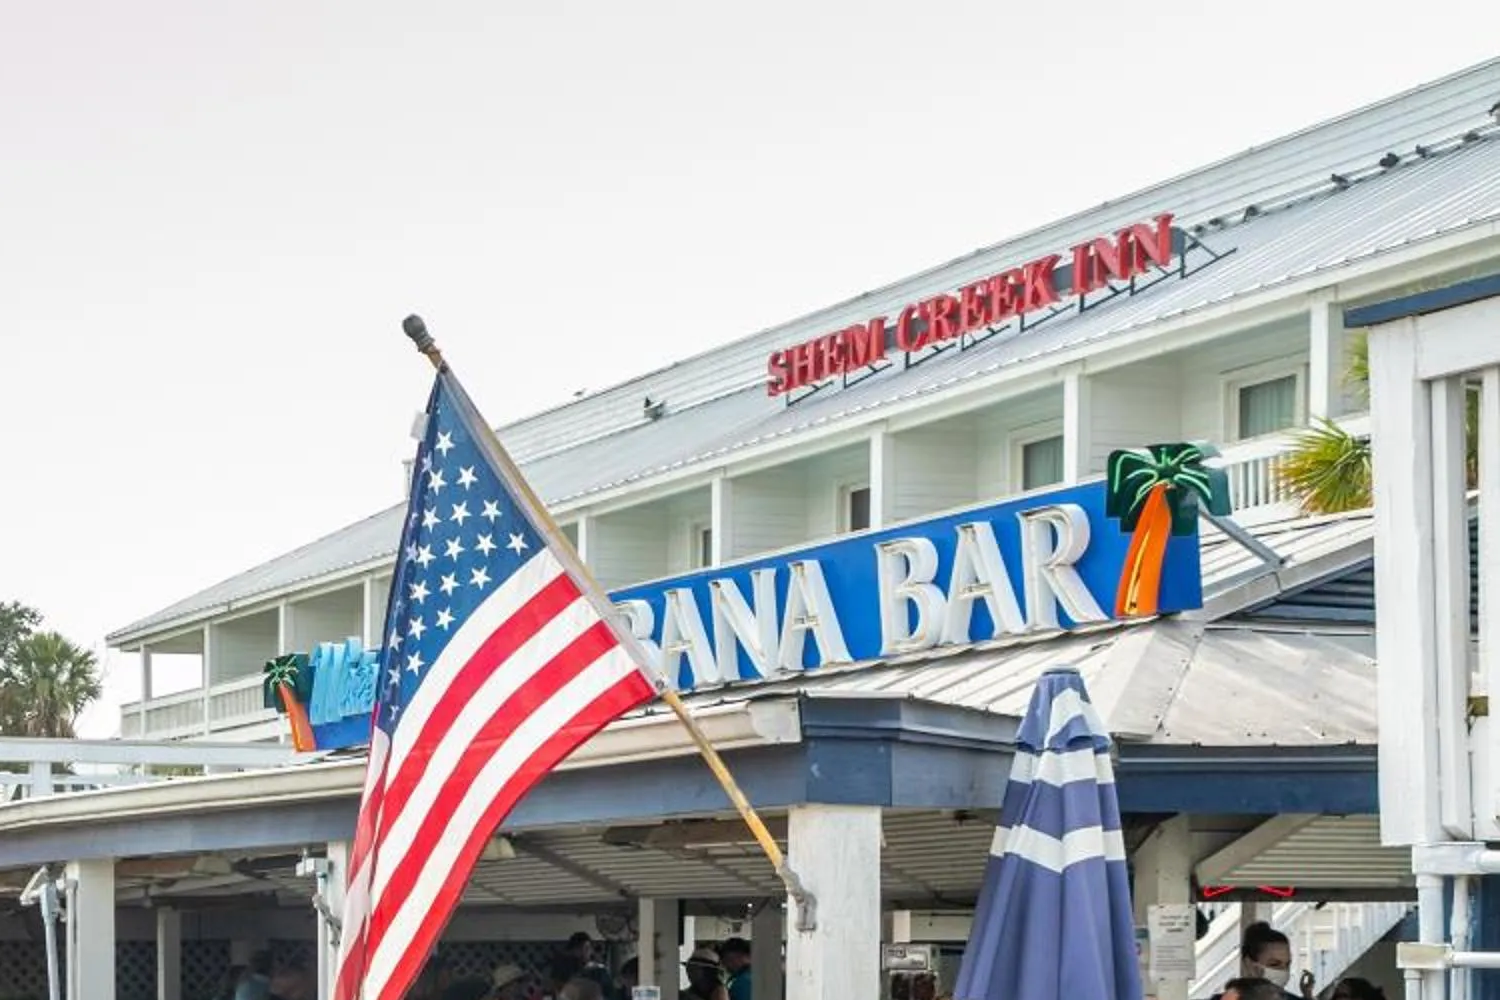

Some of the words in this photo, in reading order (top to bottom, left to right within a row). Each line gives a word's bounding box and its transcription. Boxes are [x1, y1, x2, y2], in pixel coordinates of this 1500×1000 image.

[767, 315, 889, 397] SHEM
[896, 253, 1062, 352] CREEK
[1068, 212, 1175, 296] INN
[873, 502, 1111, 656] BAR
